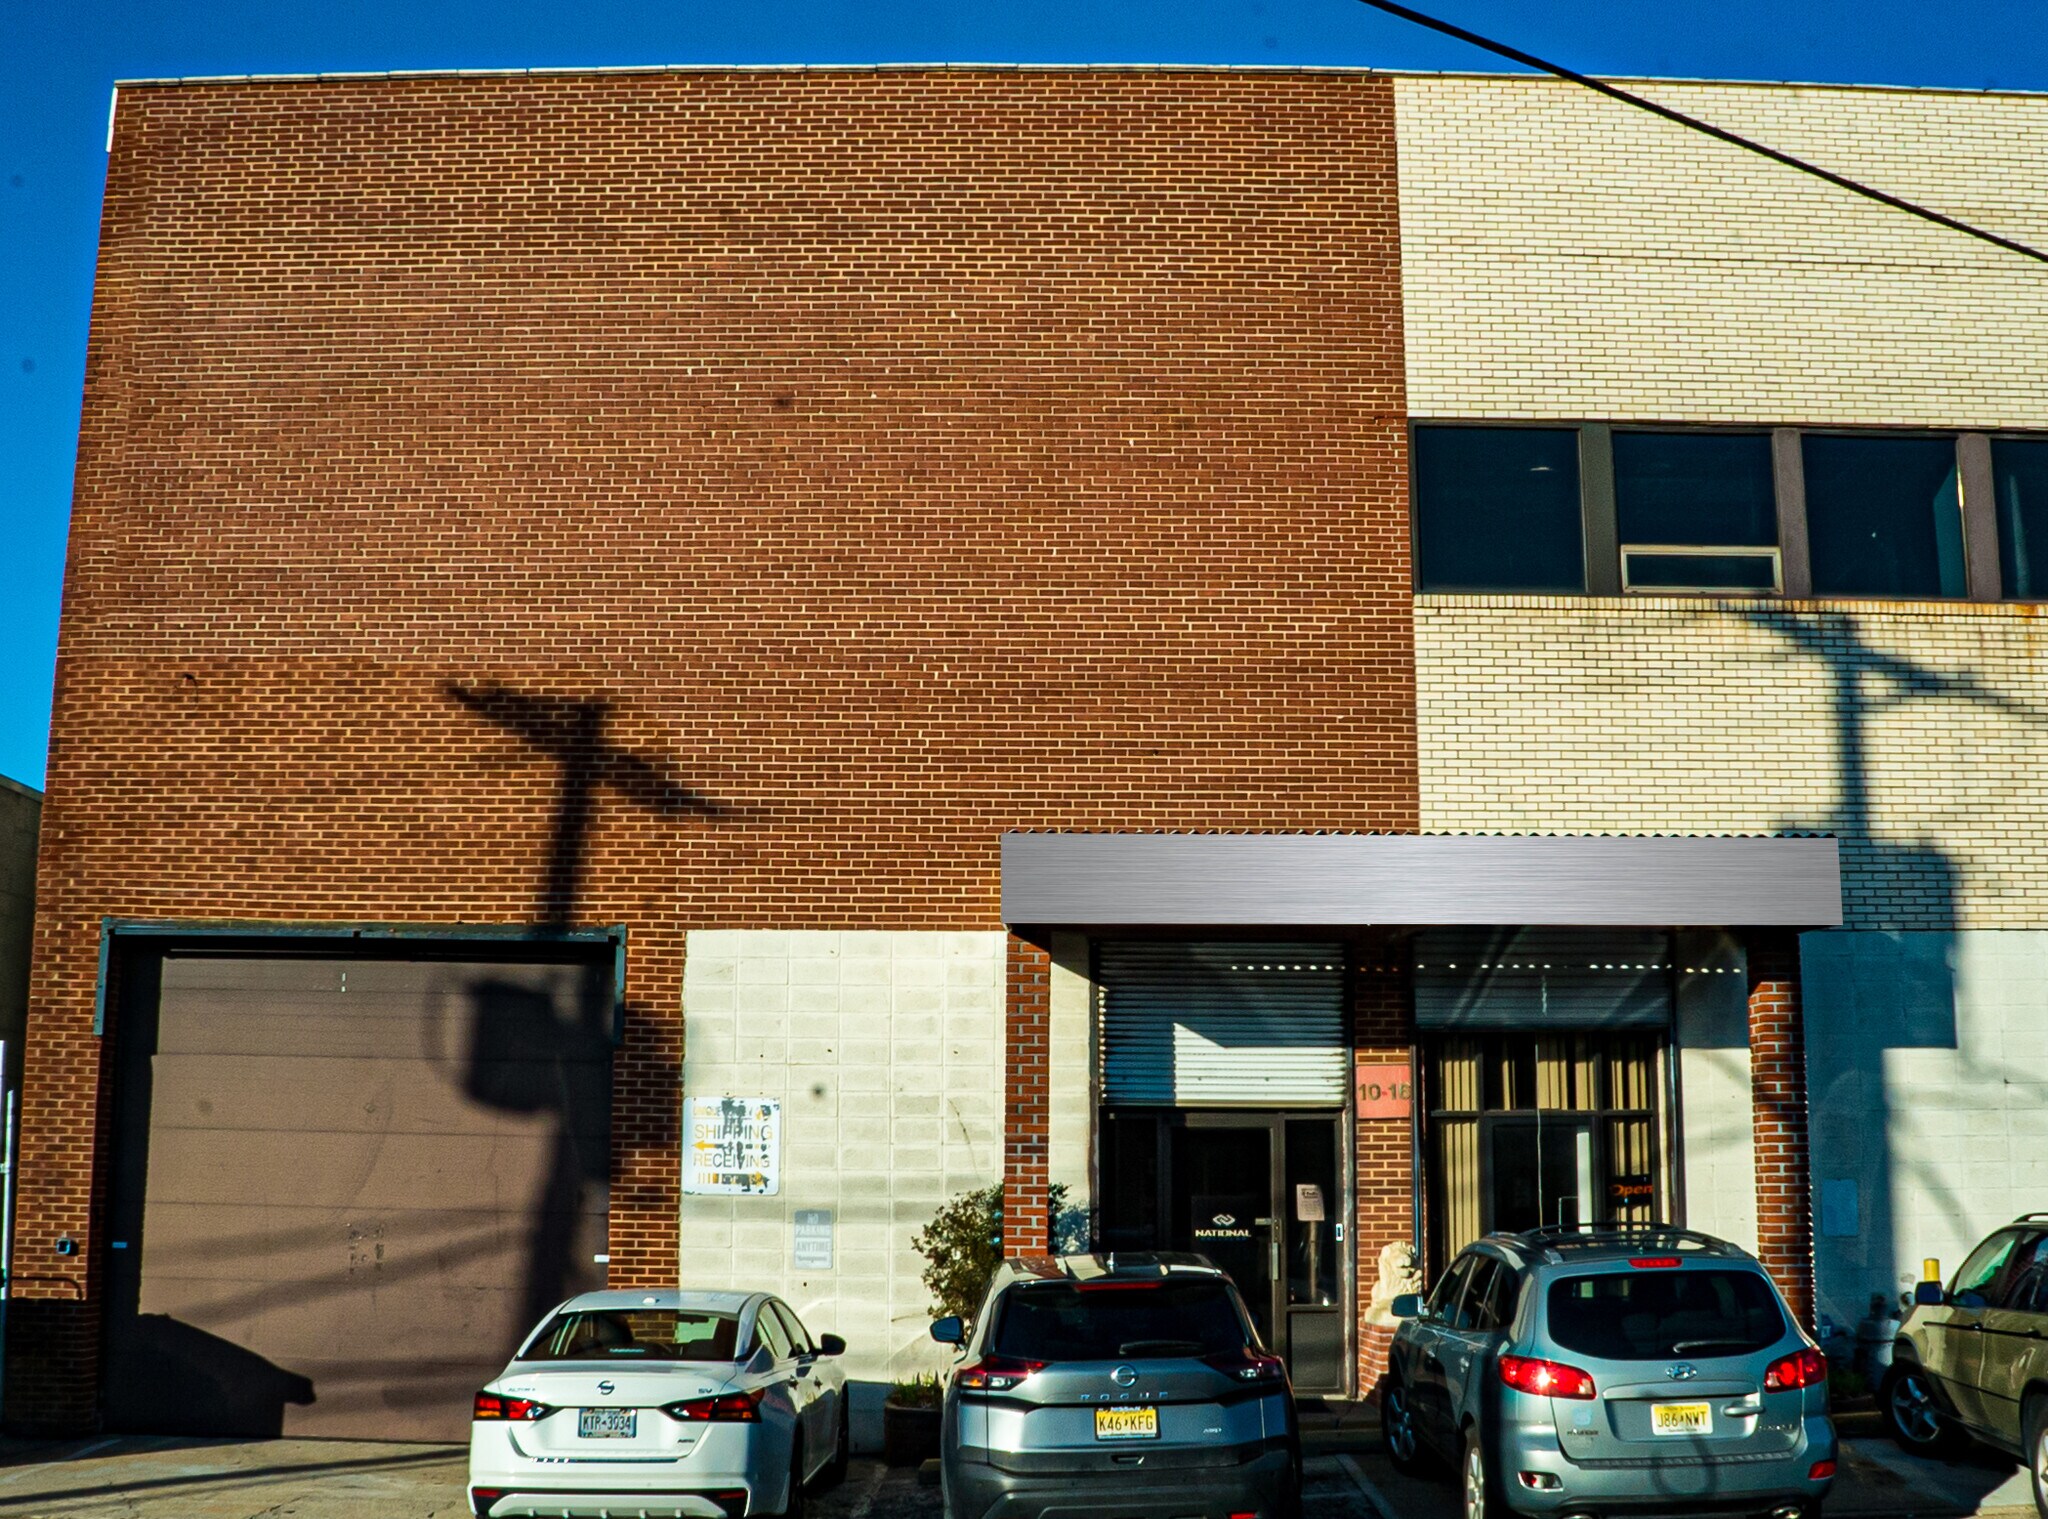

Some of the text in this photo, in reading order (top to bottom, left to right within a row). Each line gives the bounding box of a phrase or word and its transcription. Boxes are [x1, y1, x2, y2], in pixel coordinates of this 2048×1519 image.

[694, 1124, 773, 1140] SHIPPING
[693, 1153, 771, 1169] RECEIVING
[1195, 1229, 1250, 1237] NATIONAL
